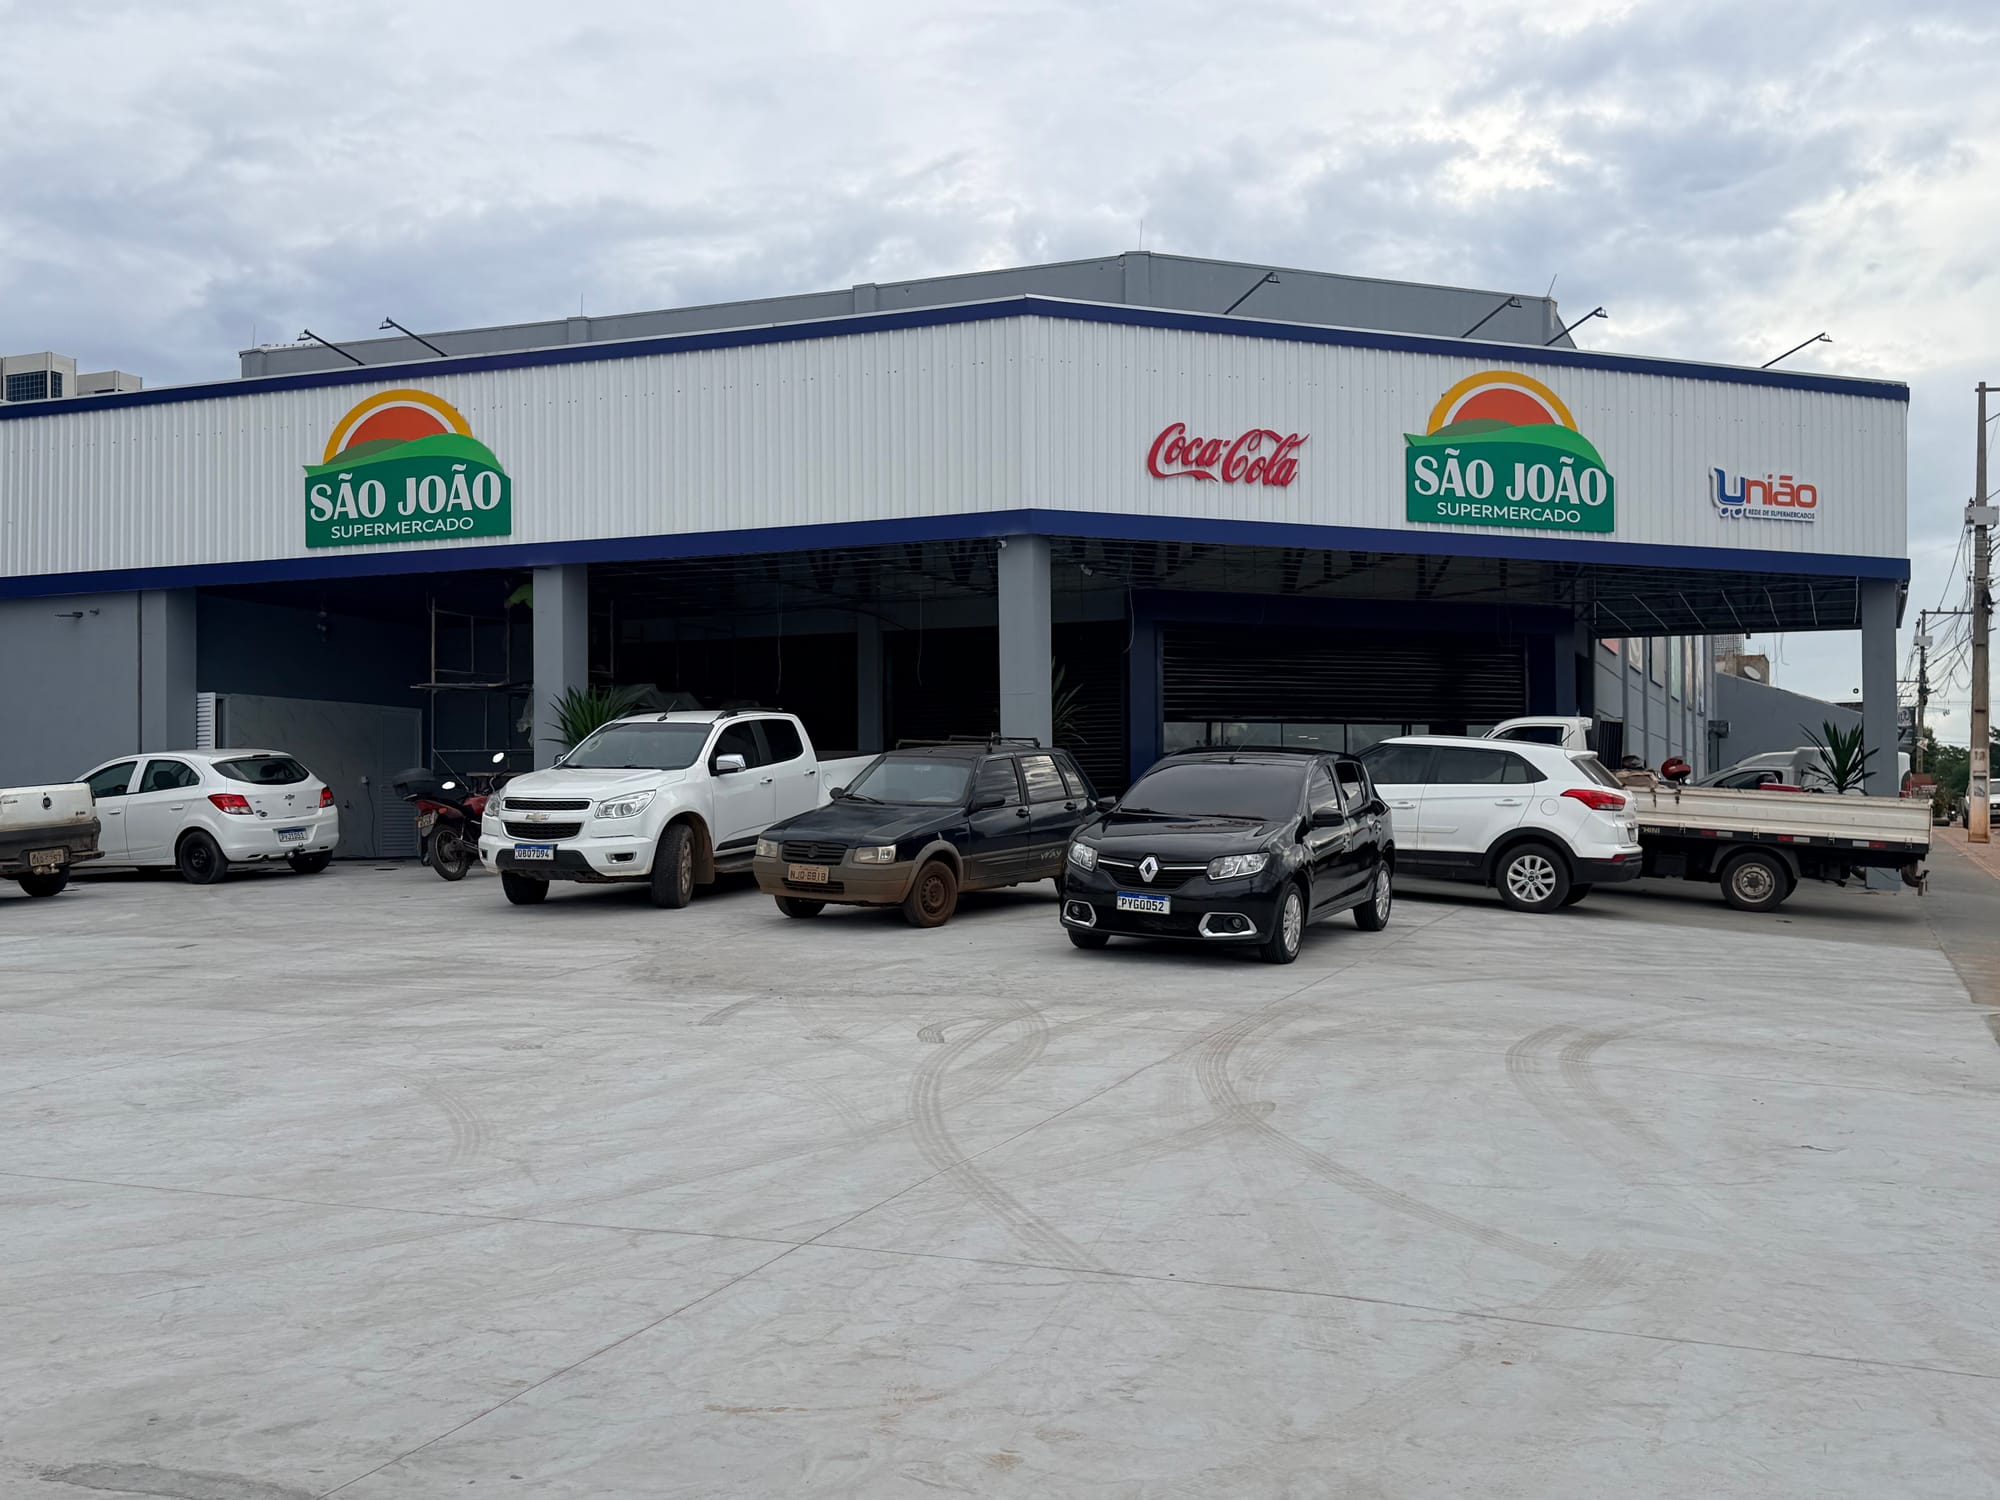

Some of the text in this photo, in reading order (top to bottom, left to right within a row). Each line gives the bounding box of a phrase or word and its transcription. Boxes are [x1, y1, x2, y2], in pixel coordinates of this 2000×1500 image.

[1148, 422, 1310, 486] Coca-Cola
[309, 463, 502, 522] SÃO JOÃO
[1414, 447, 1607, 506] SÃO JOÃO
[331, 517, 474, 539] SUPERMERCADO
[1436, 502, 1581, 523] SUPERMERCADO
[1747, 508, 1761, 516] REDE
[1770, 510, 1815, 520] SUPERMERCADOS
